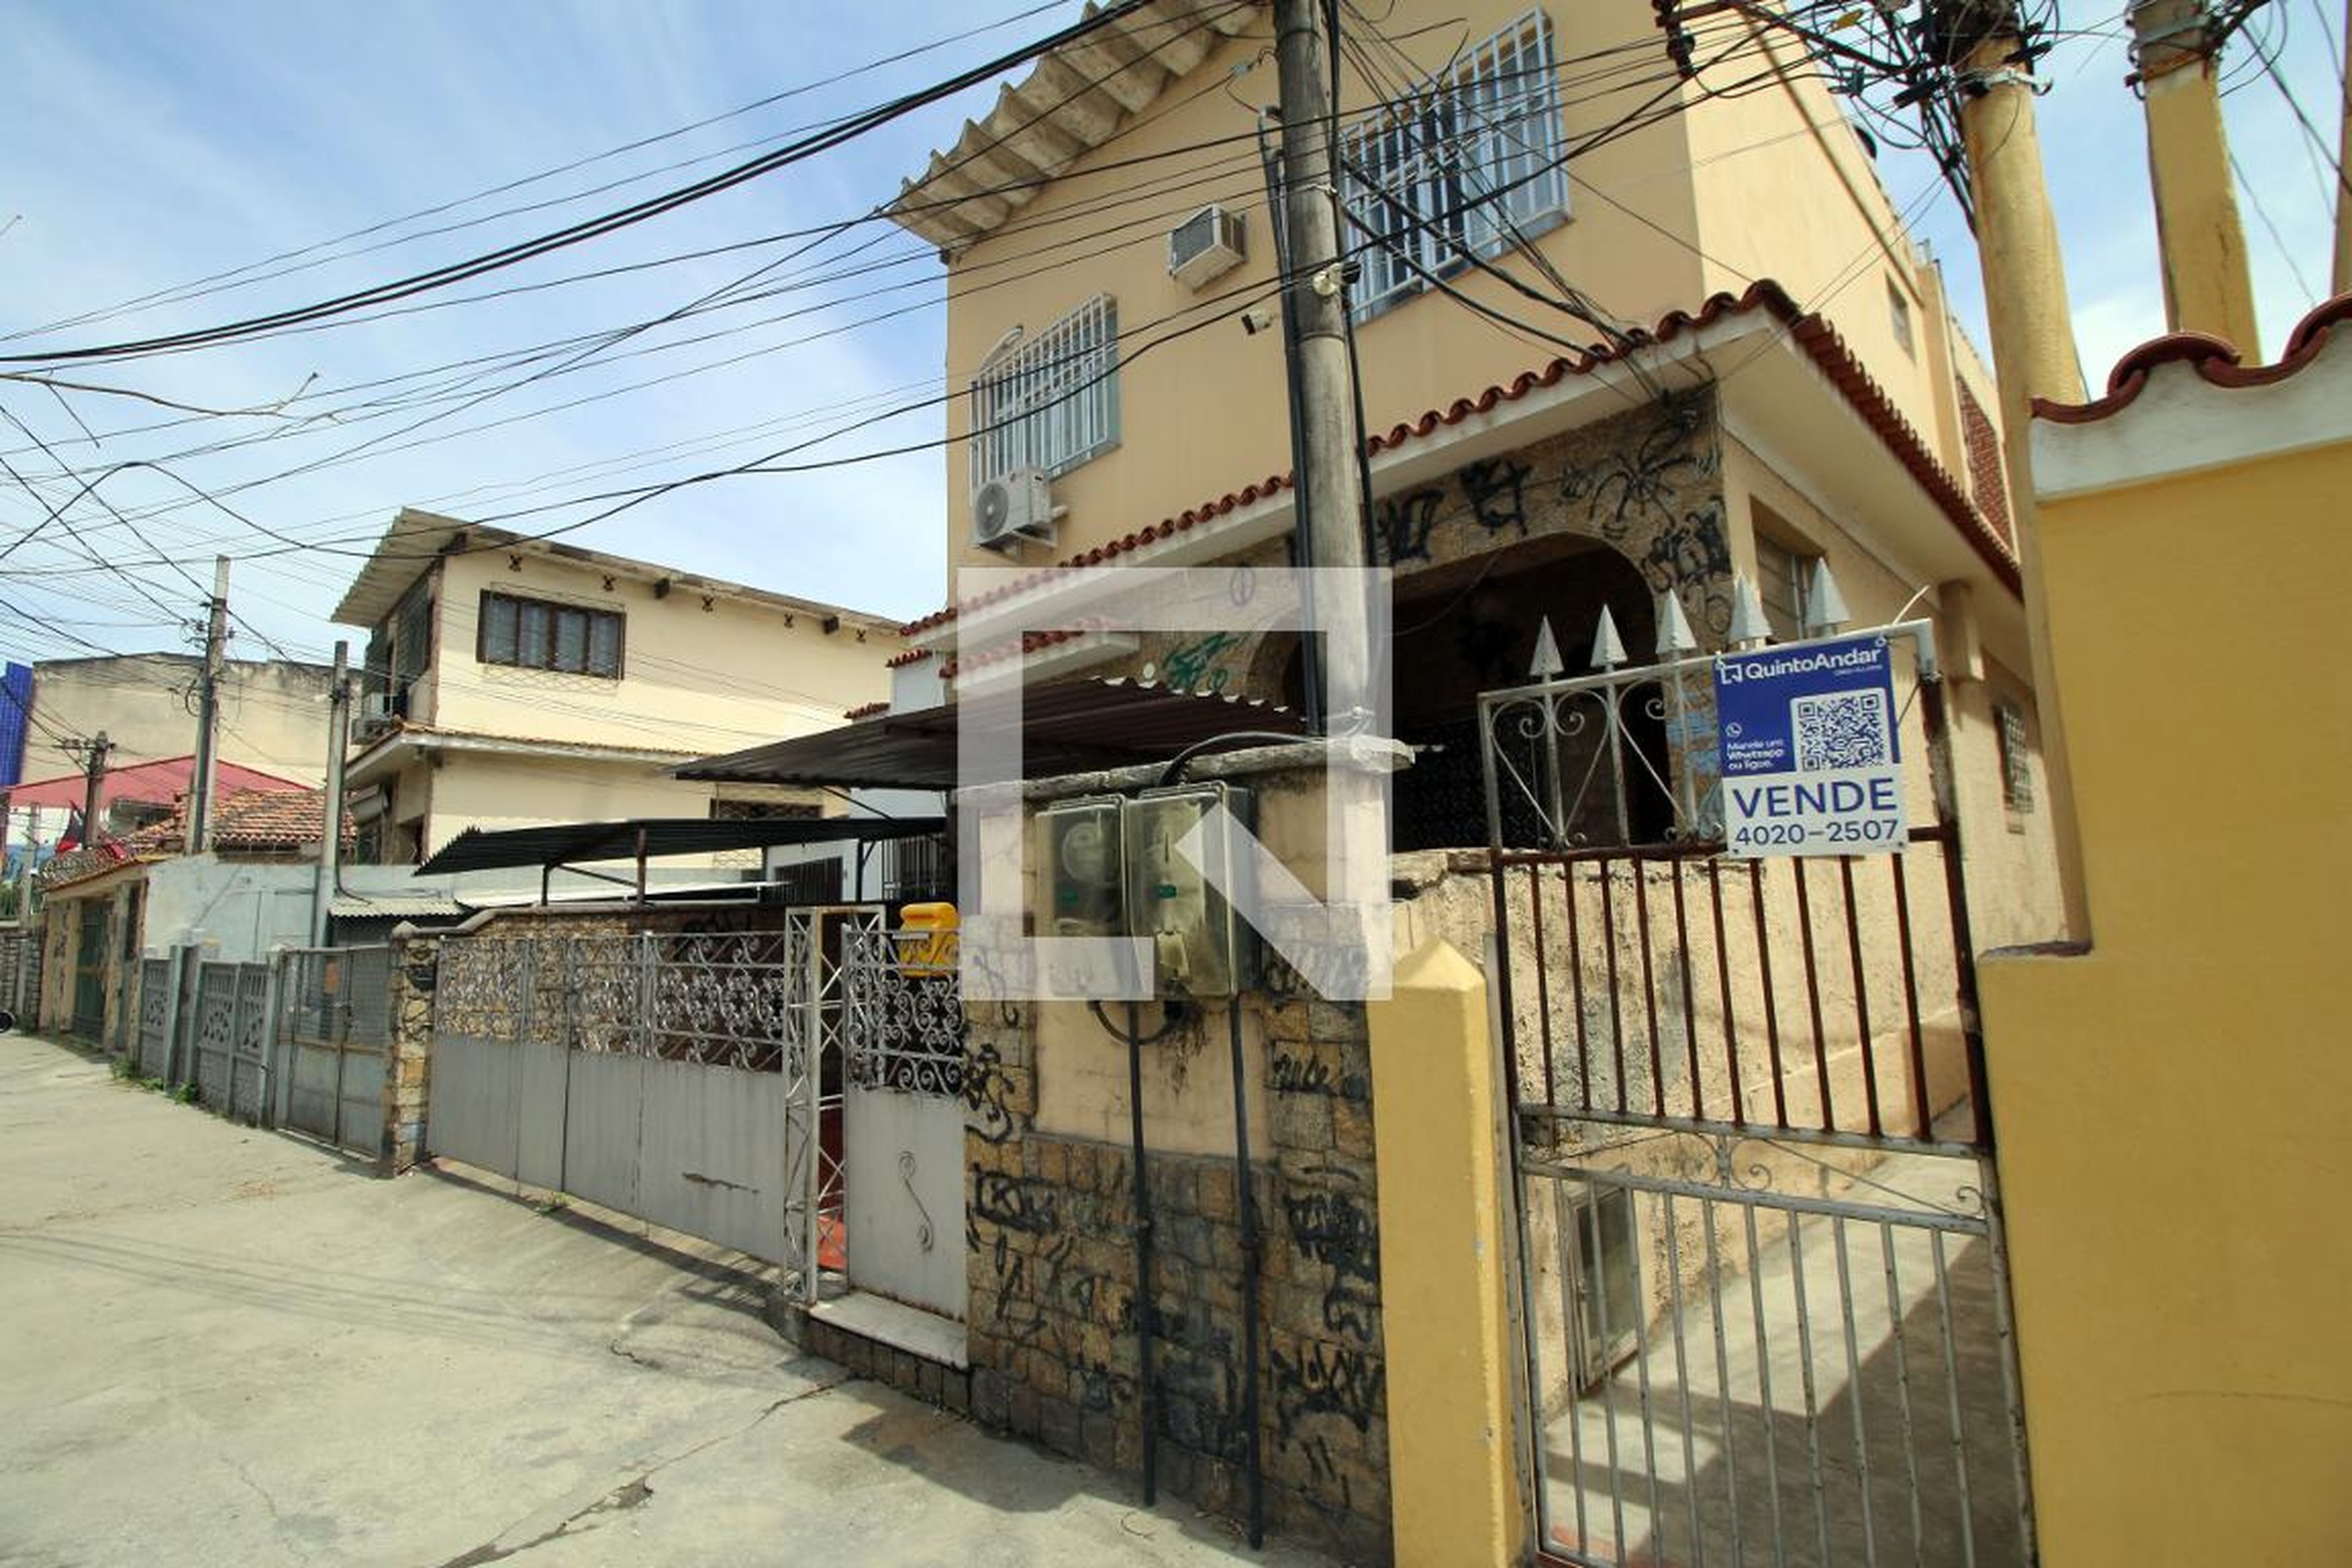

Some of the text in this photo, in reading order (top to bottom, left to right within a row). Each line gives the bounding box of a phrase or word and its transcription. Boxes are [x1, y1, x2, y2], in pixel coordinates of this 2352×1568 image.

[1746, 647, 1881, 679] QuintoAndar
[1732, 777, 1898, 819] VENDE
[1735, 819, 1898, 846] 4020-2507
